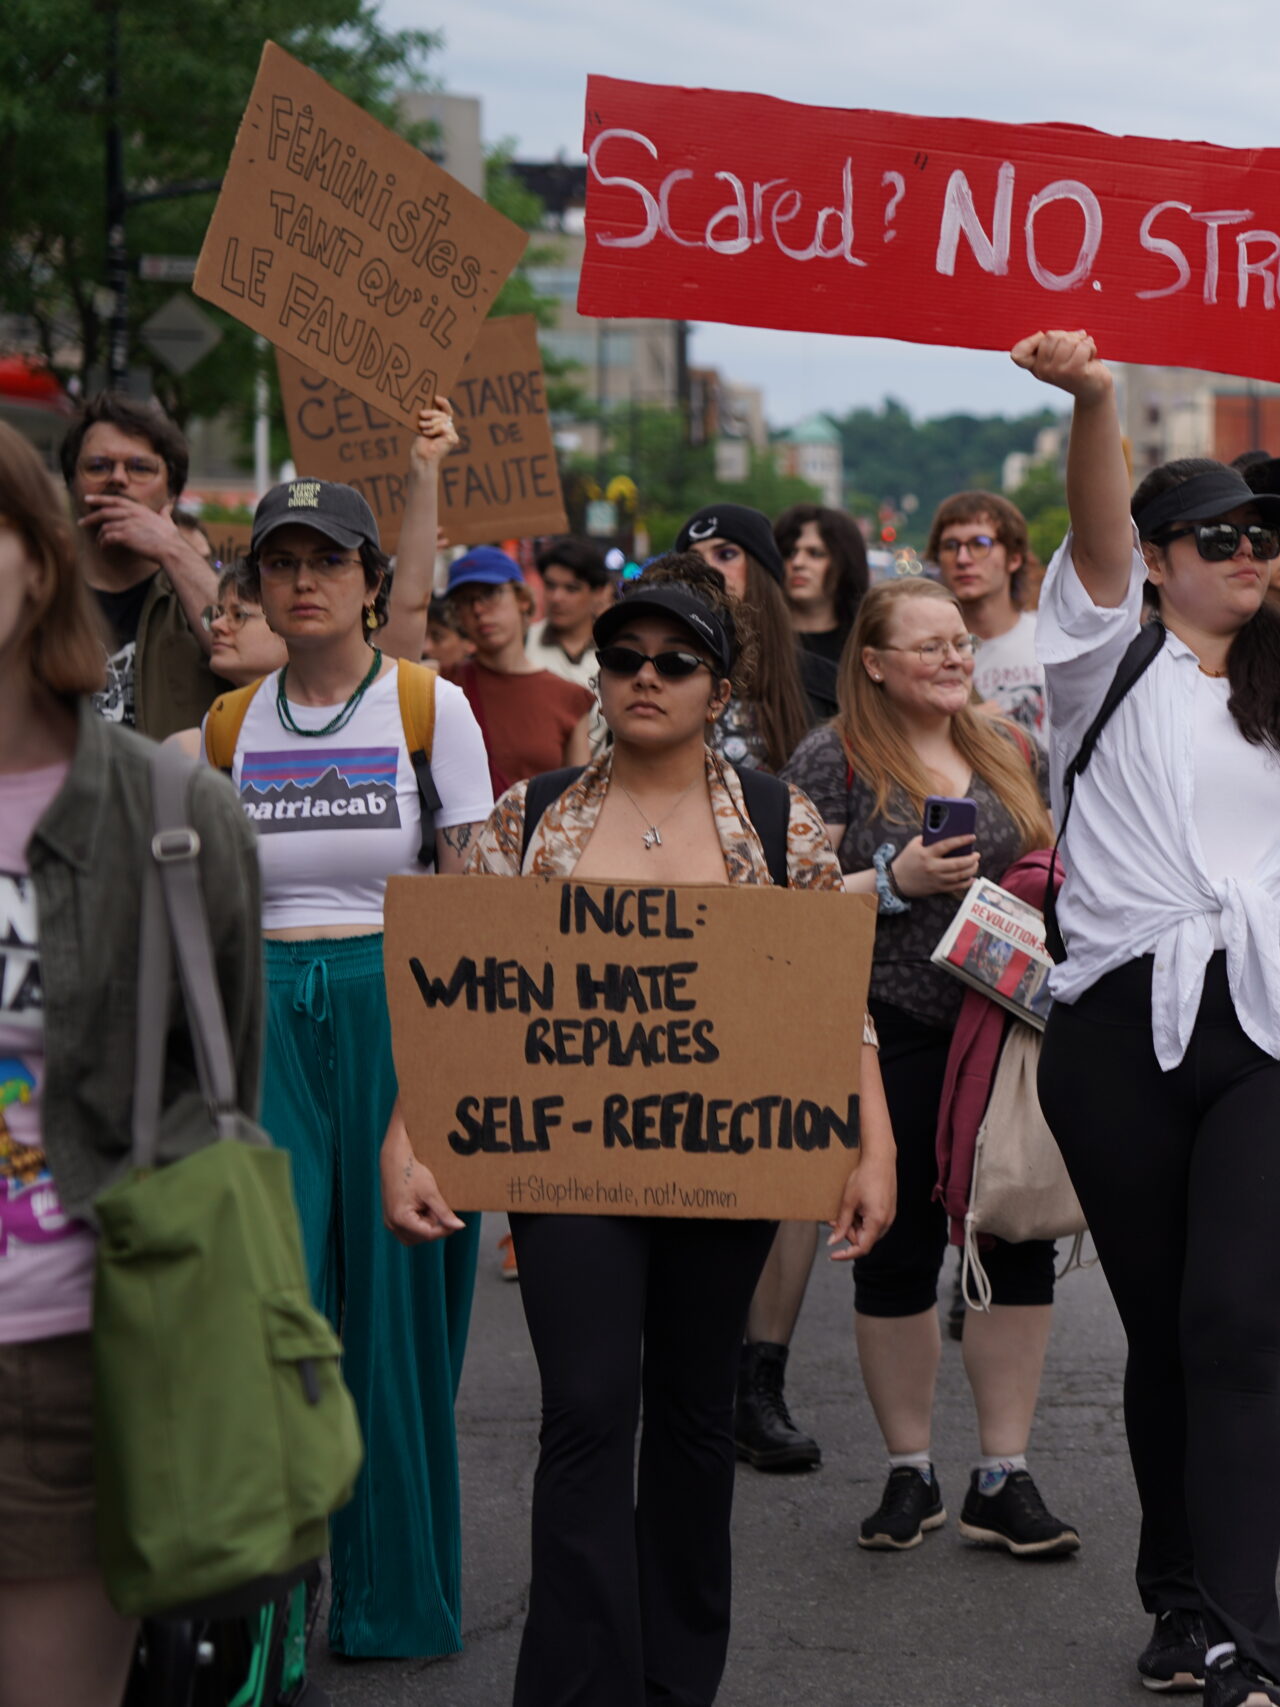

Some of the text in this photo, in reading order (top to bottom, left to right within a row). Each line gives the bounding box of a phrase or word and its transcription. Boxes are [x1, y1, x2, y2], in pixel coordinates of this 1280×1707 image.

[270, 189, 363, 278] TANT
[936, 160, 1102, 292] NO.
[221, 236, 438, 415] LE FAUDRA
[489, 422, 524, 446] DE
[442, 454, 554, 508] FAUTE
[559, 883, 708, 939] INCEL:
[970, 902, 1039, 948] RÉVOLUTION
[408, 955, 699, 1014] WHEN HATE
[524, 1017, 720, 1067] REPLACES
